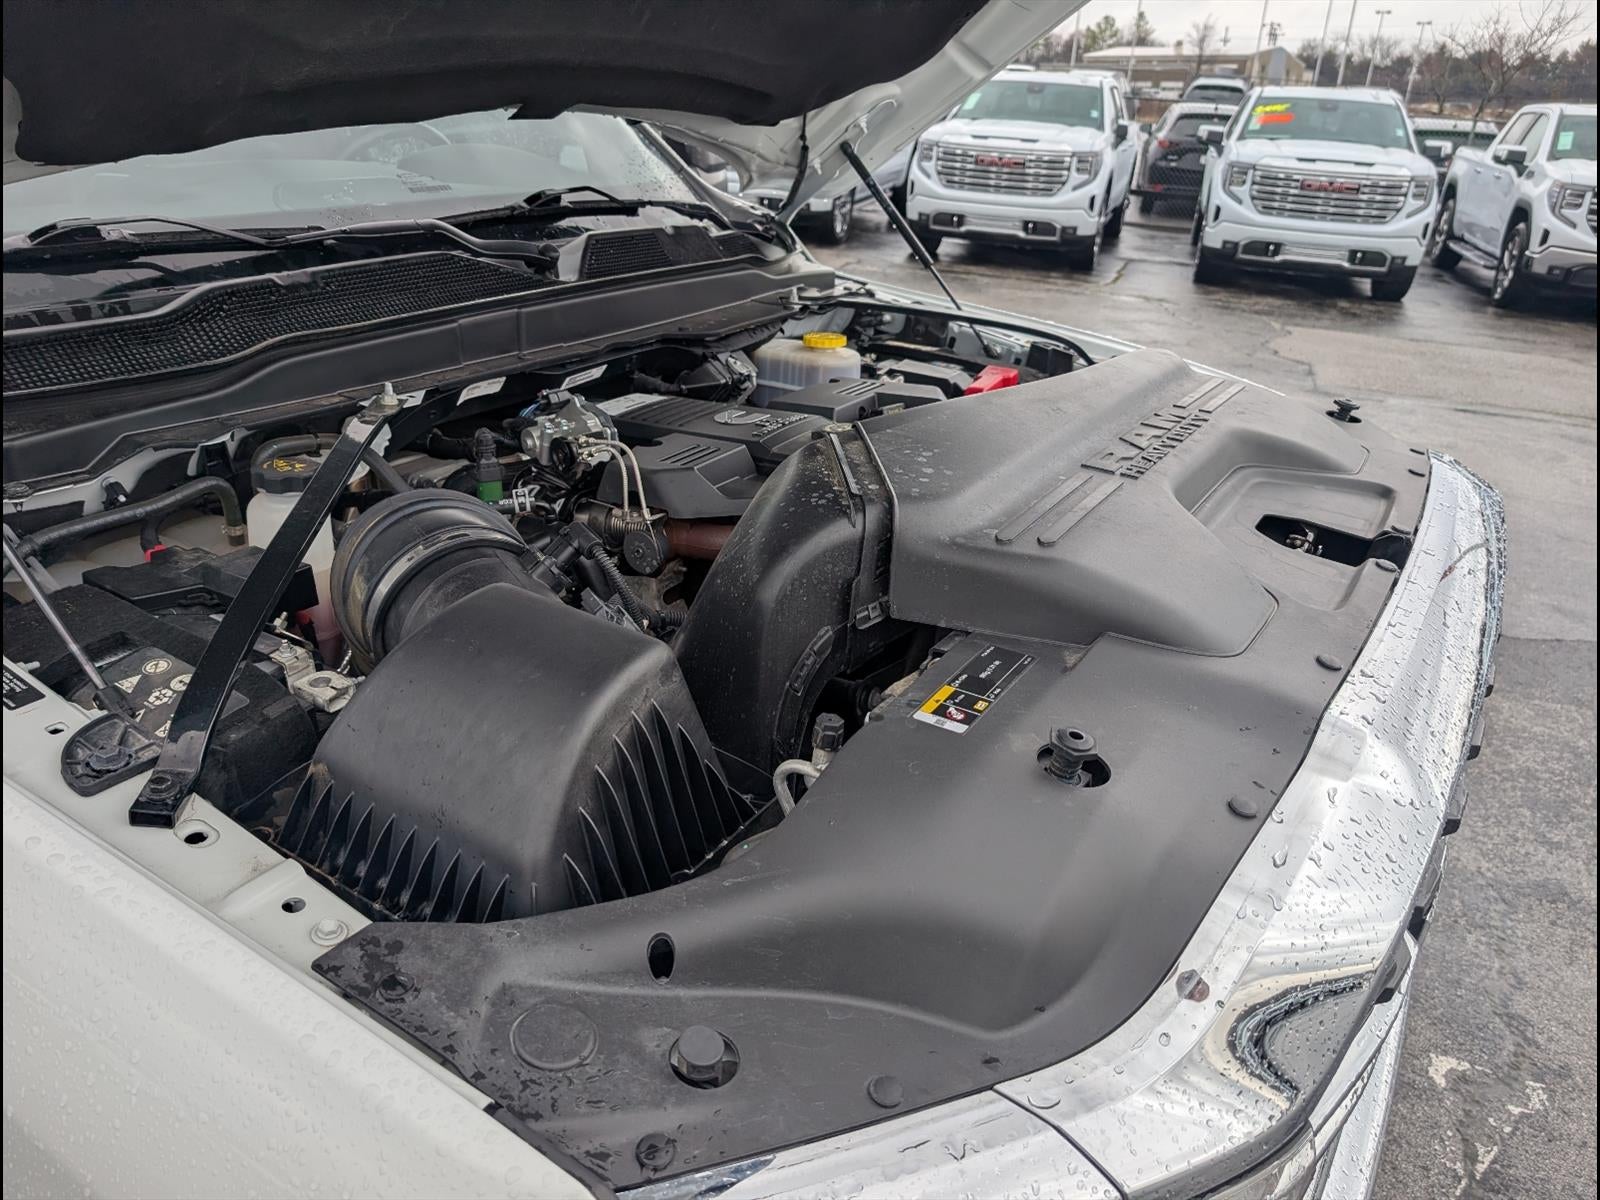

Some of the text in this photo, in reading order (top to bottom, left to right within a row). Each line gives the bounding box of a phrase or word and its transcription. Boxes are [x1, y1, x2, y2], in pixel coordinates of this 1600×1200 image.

[975, 154, 1025, 169] GMC
[1300, 179, 1360, 194] GMC
[1080, 408, 1192, 475] RAM
[1120, 440, 1178, 480] HEAVY
